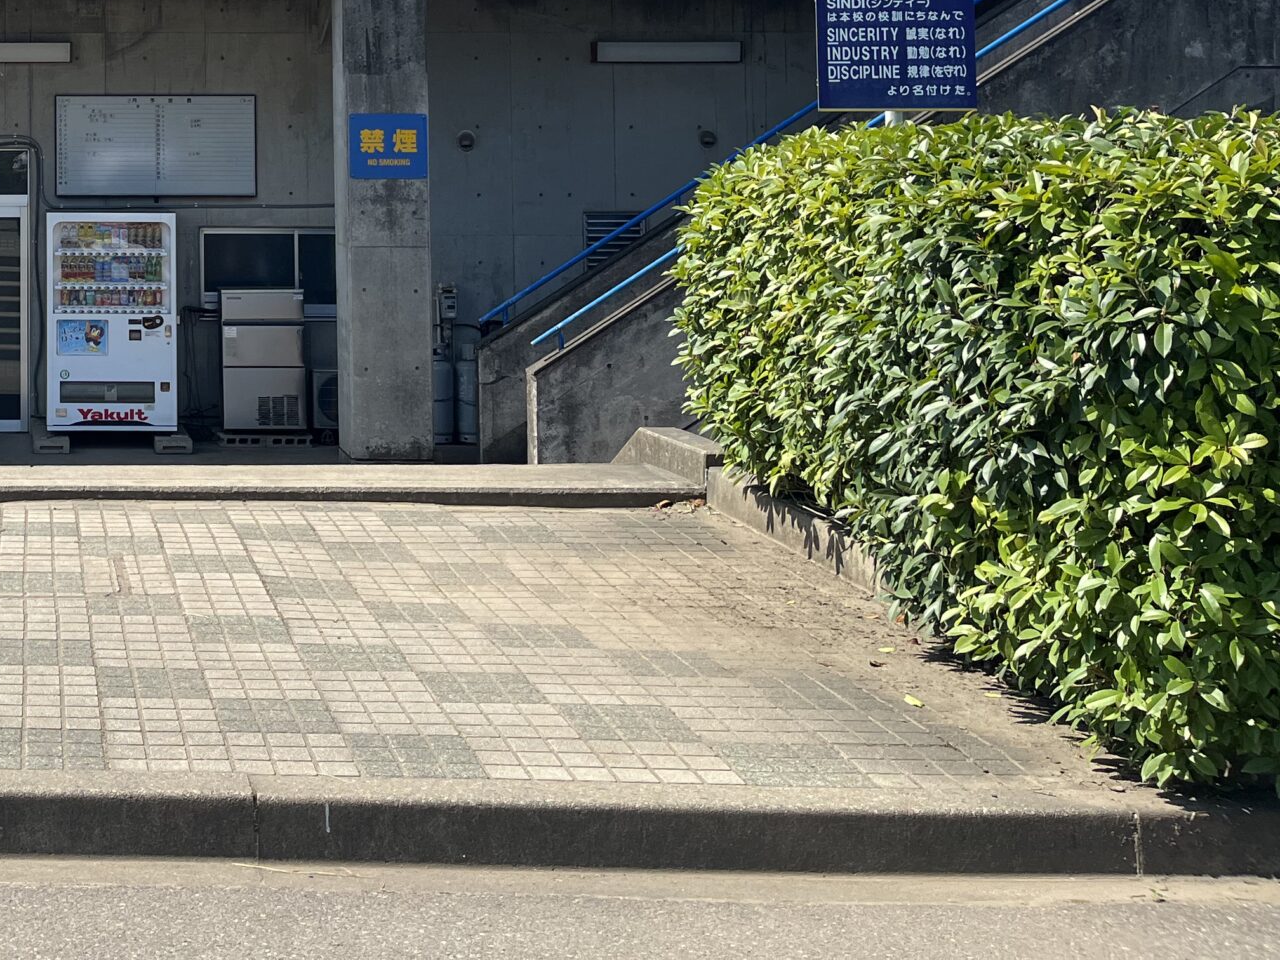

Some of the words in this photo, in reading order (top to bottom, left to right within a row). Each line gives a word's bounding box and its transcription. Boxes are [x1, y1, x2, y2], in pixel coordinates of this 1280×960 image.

[827, 10, 964, 23] は本校の校訓にちなんで
[827, 27, 899, 42] SINCERITY
[827, 45, 899, 61] INDUSTRY
[827, 64, 901, 79] DISCIPLINE
[887, 84, 972, 96] より名付けた。
[359, 128, 418, 154] 禁煙
[76, 407, 150, 421] Yakult
